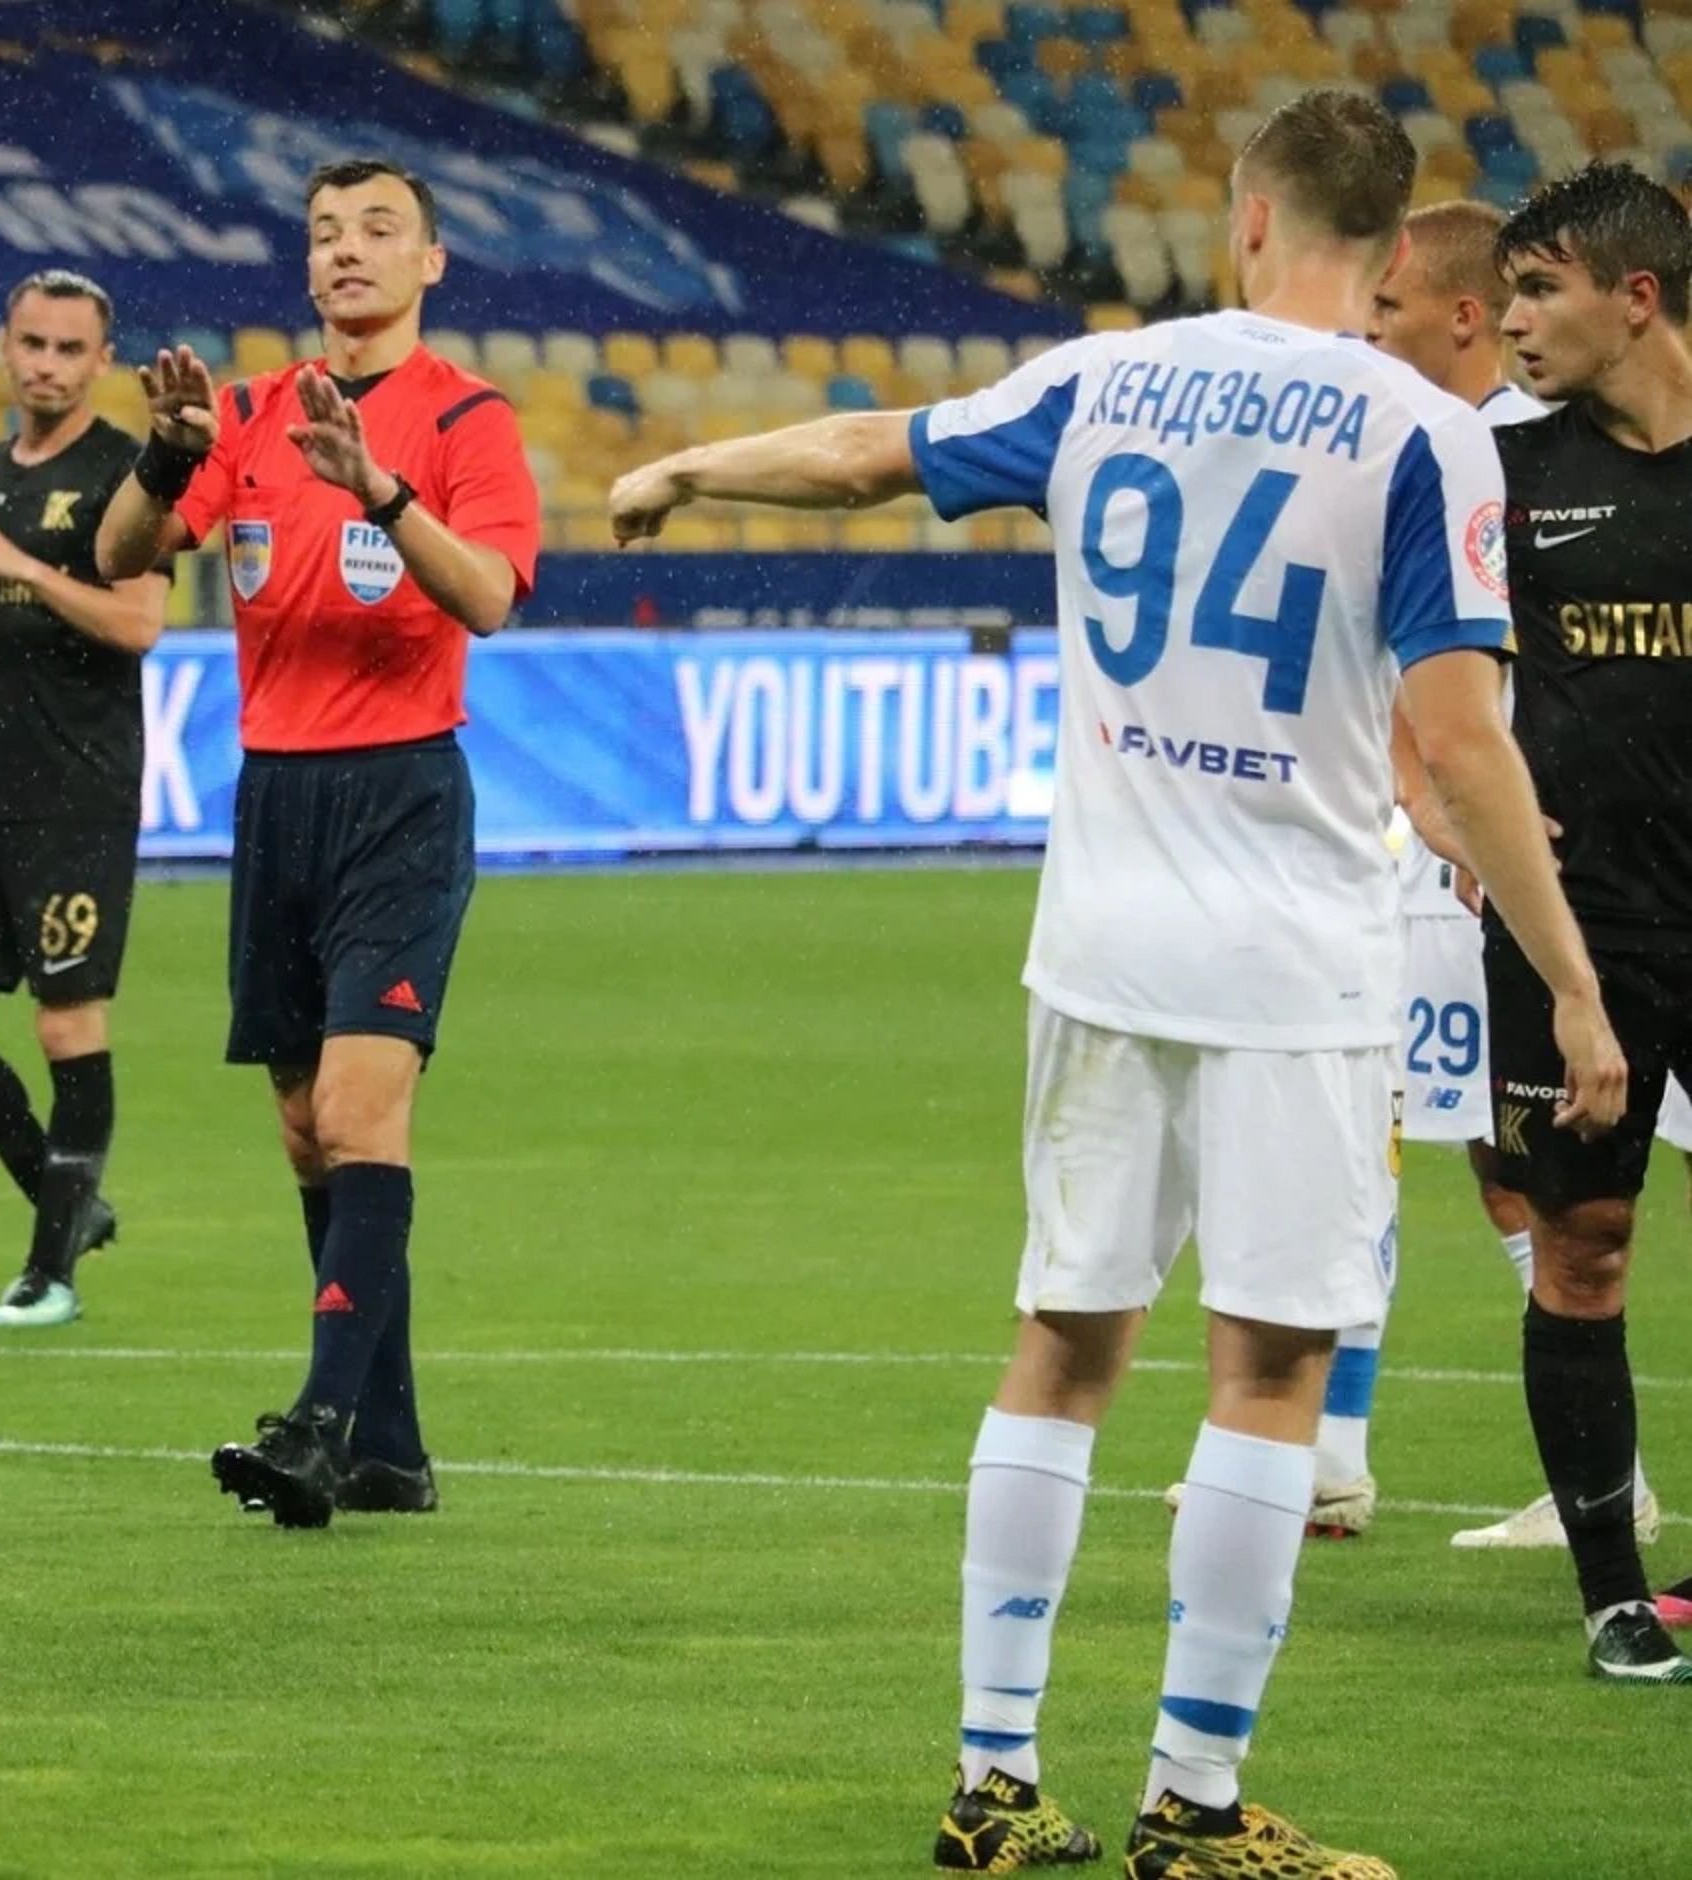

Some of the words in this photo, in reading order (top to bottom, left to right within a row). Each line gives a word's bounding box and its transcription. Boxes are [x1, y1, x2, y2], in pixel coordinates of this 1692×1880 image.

[1528, 505, 1617, 523] FAVBET
[1080, 451, 1328, 716] 94
[674, 657, 1060, 824] YOUTUBE
[41, 892, 98, 957] 69
[1406, 996, 1481, 1077] 29
